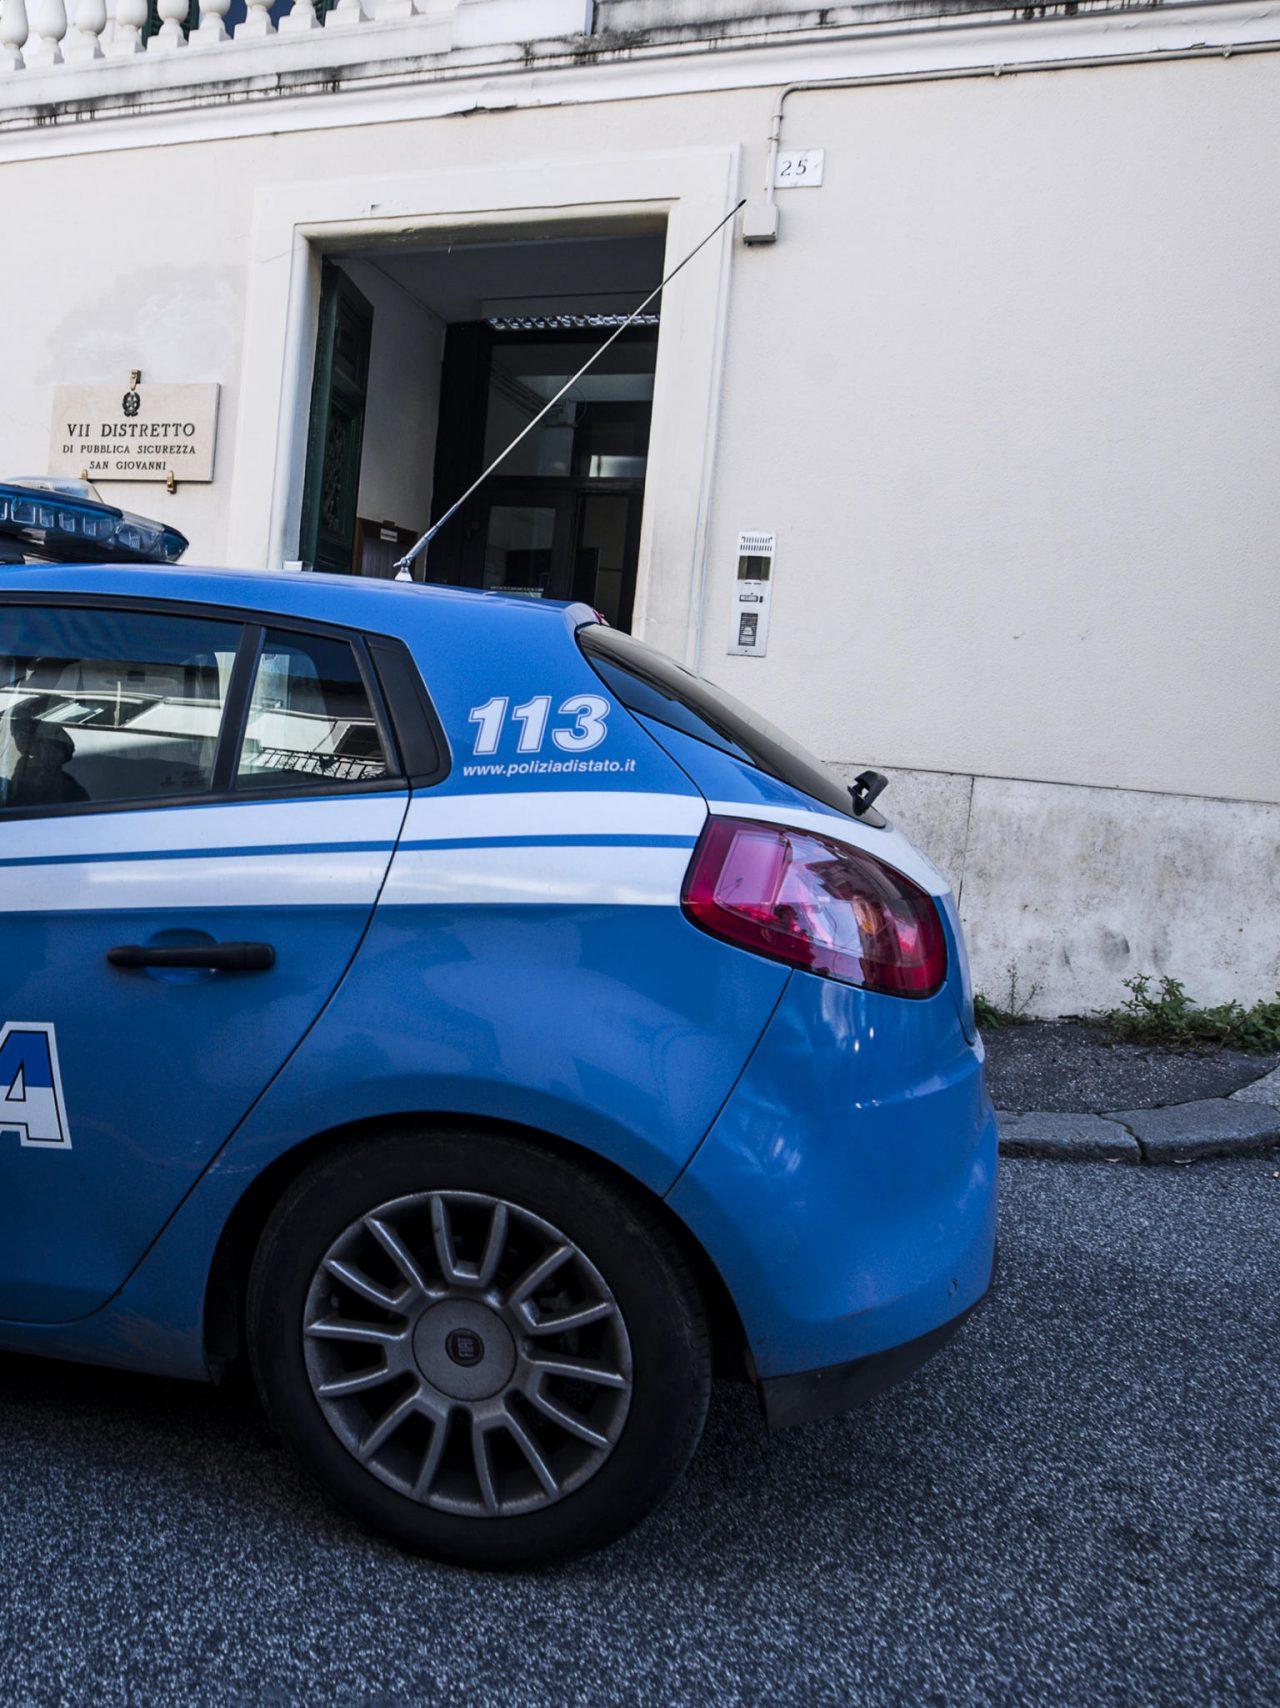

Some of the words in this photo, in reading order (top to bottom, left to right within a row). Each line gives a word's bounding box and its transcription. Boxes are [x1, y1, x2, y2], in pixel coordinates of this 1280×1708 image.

[780, 159, 808, 176] 25
[67, 423, 90, 437] VII
[101, 422, 196, 437] DISTRETTO
[63, 444, 73, 454] DI
[80, 444, 130, 454] PUBBLICA
[137, 445, 196, 454] SICUREZZA
[89, 461, 109, 470] SAN
[116, 461, 166, 470] GIOVANNI
[468, 693, 610, 755] 113
[463, 759, 636, 777] www.poliziadistato.it
